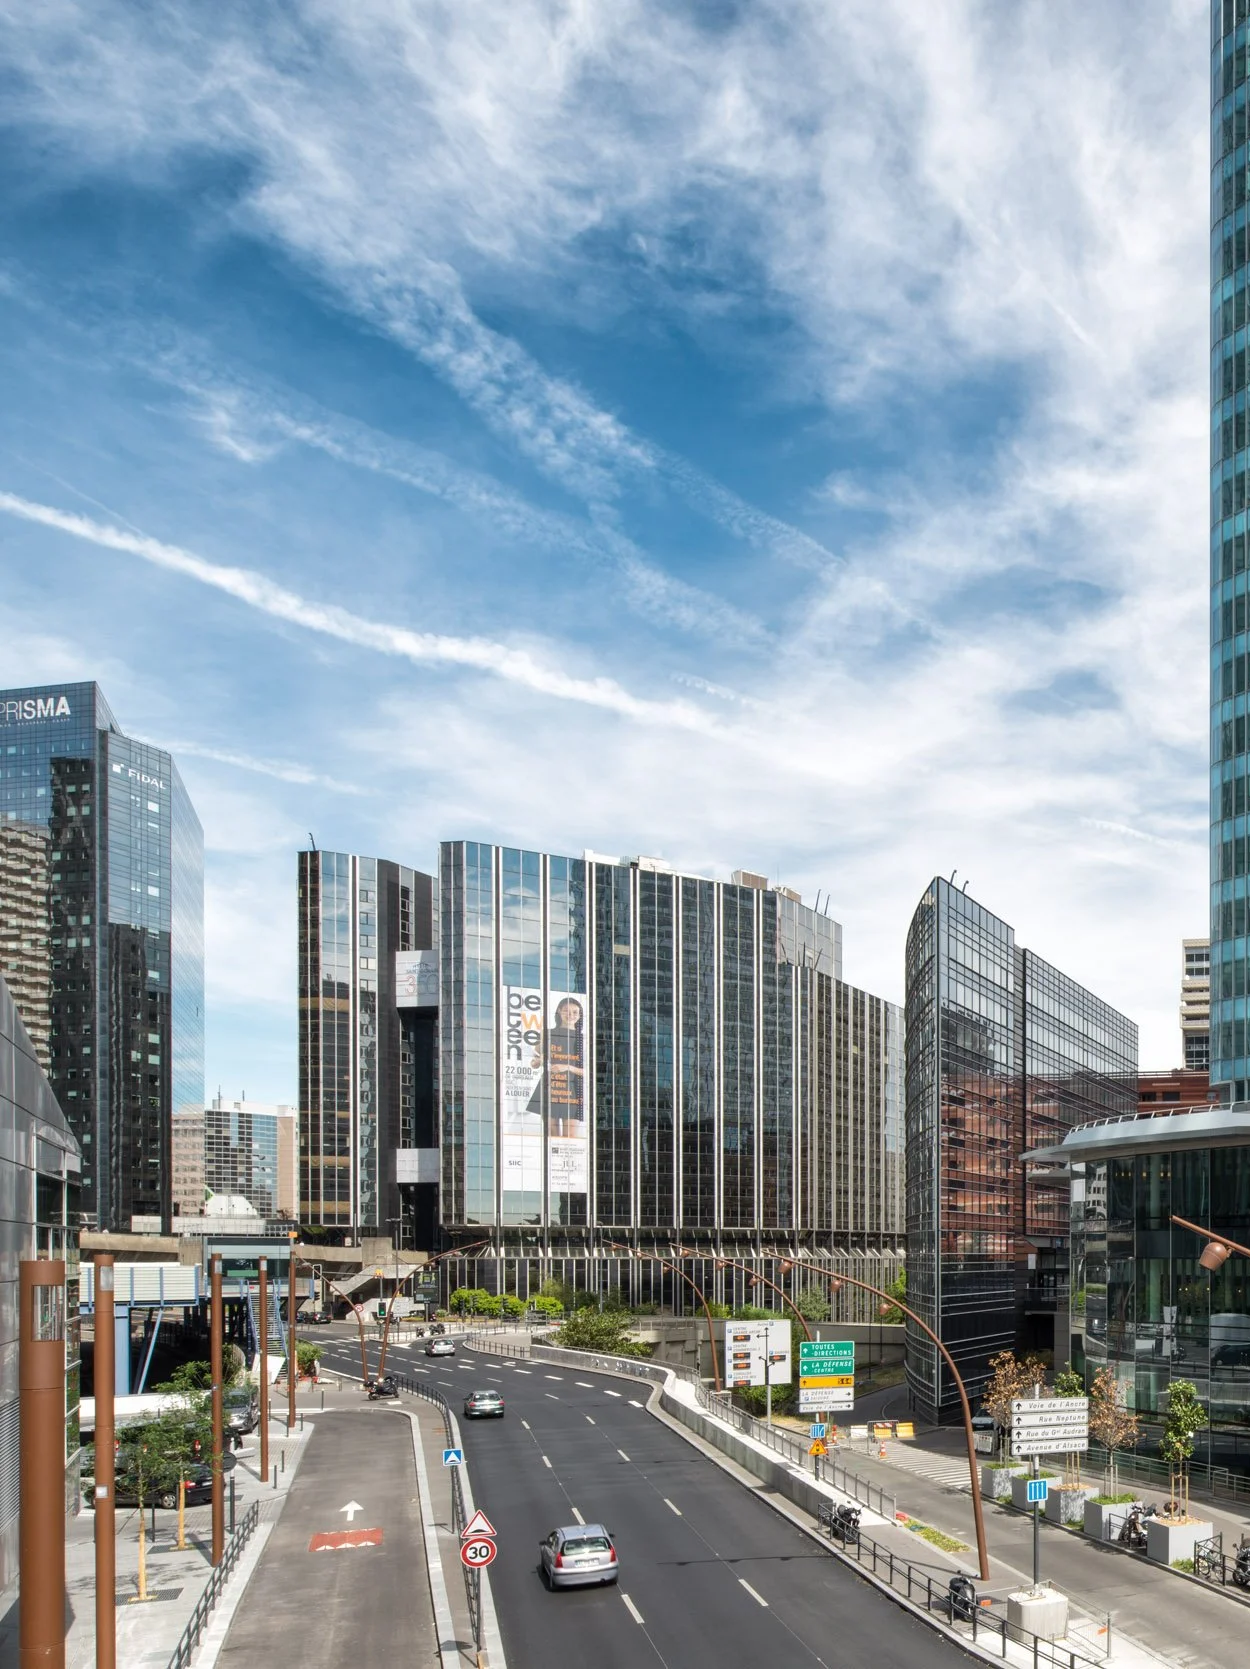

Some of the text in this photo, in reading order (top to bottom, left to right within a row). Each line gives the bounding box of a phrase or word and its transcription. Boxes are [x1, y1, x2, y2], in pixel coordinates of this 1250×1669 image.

[128, 768, 167, 790] FIDAL
[505, 1066, 515, 1074] 22
[517, 1066, 532, 1075] 000
[1055, 1442, 1085, 1450] d'Alsace
[469, 1545, 490, 1559] 30
